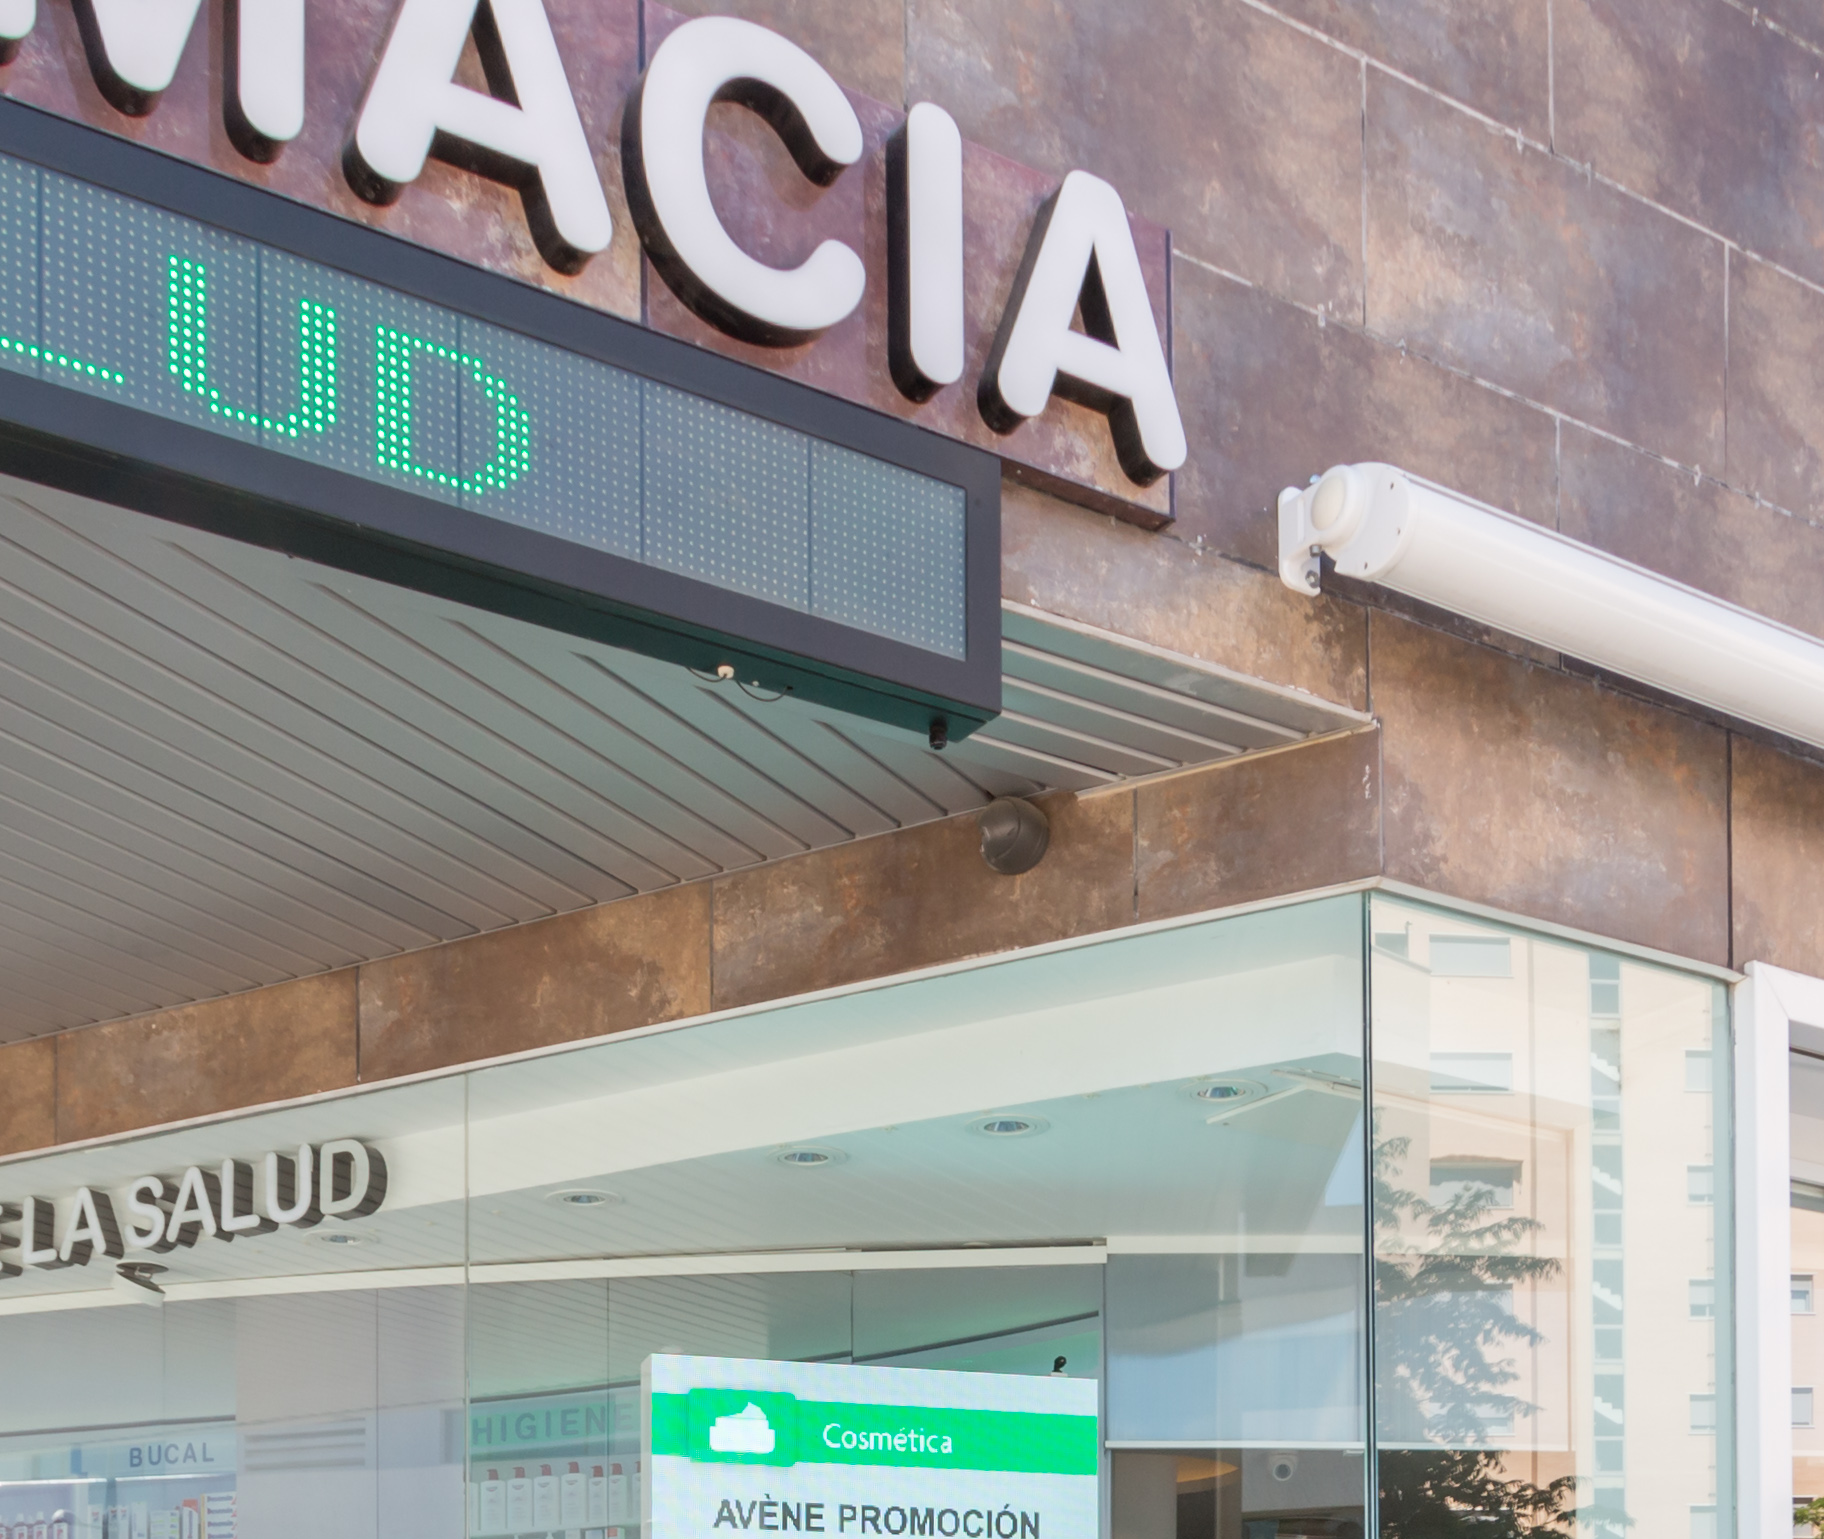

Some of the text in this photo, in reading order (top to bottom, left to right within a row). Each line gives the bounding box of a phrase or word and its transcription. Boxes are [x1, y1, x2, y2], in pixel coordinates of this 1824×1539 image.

[22, 1186, 116, 1266] LA
[126, 1138, 386, 1252] SALUD
[471, 1402, 634, 1445] HIGIENE
[822, 1422, 954, 1456] Cosmética
[129, 1441, 215, 1469] BUCAL
[712, 1493, 825, 1533] AVÈNE
